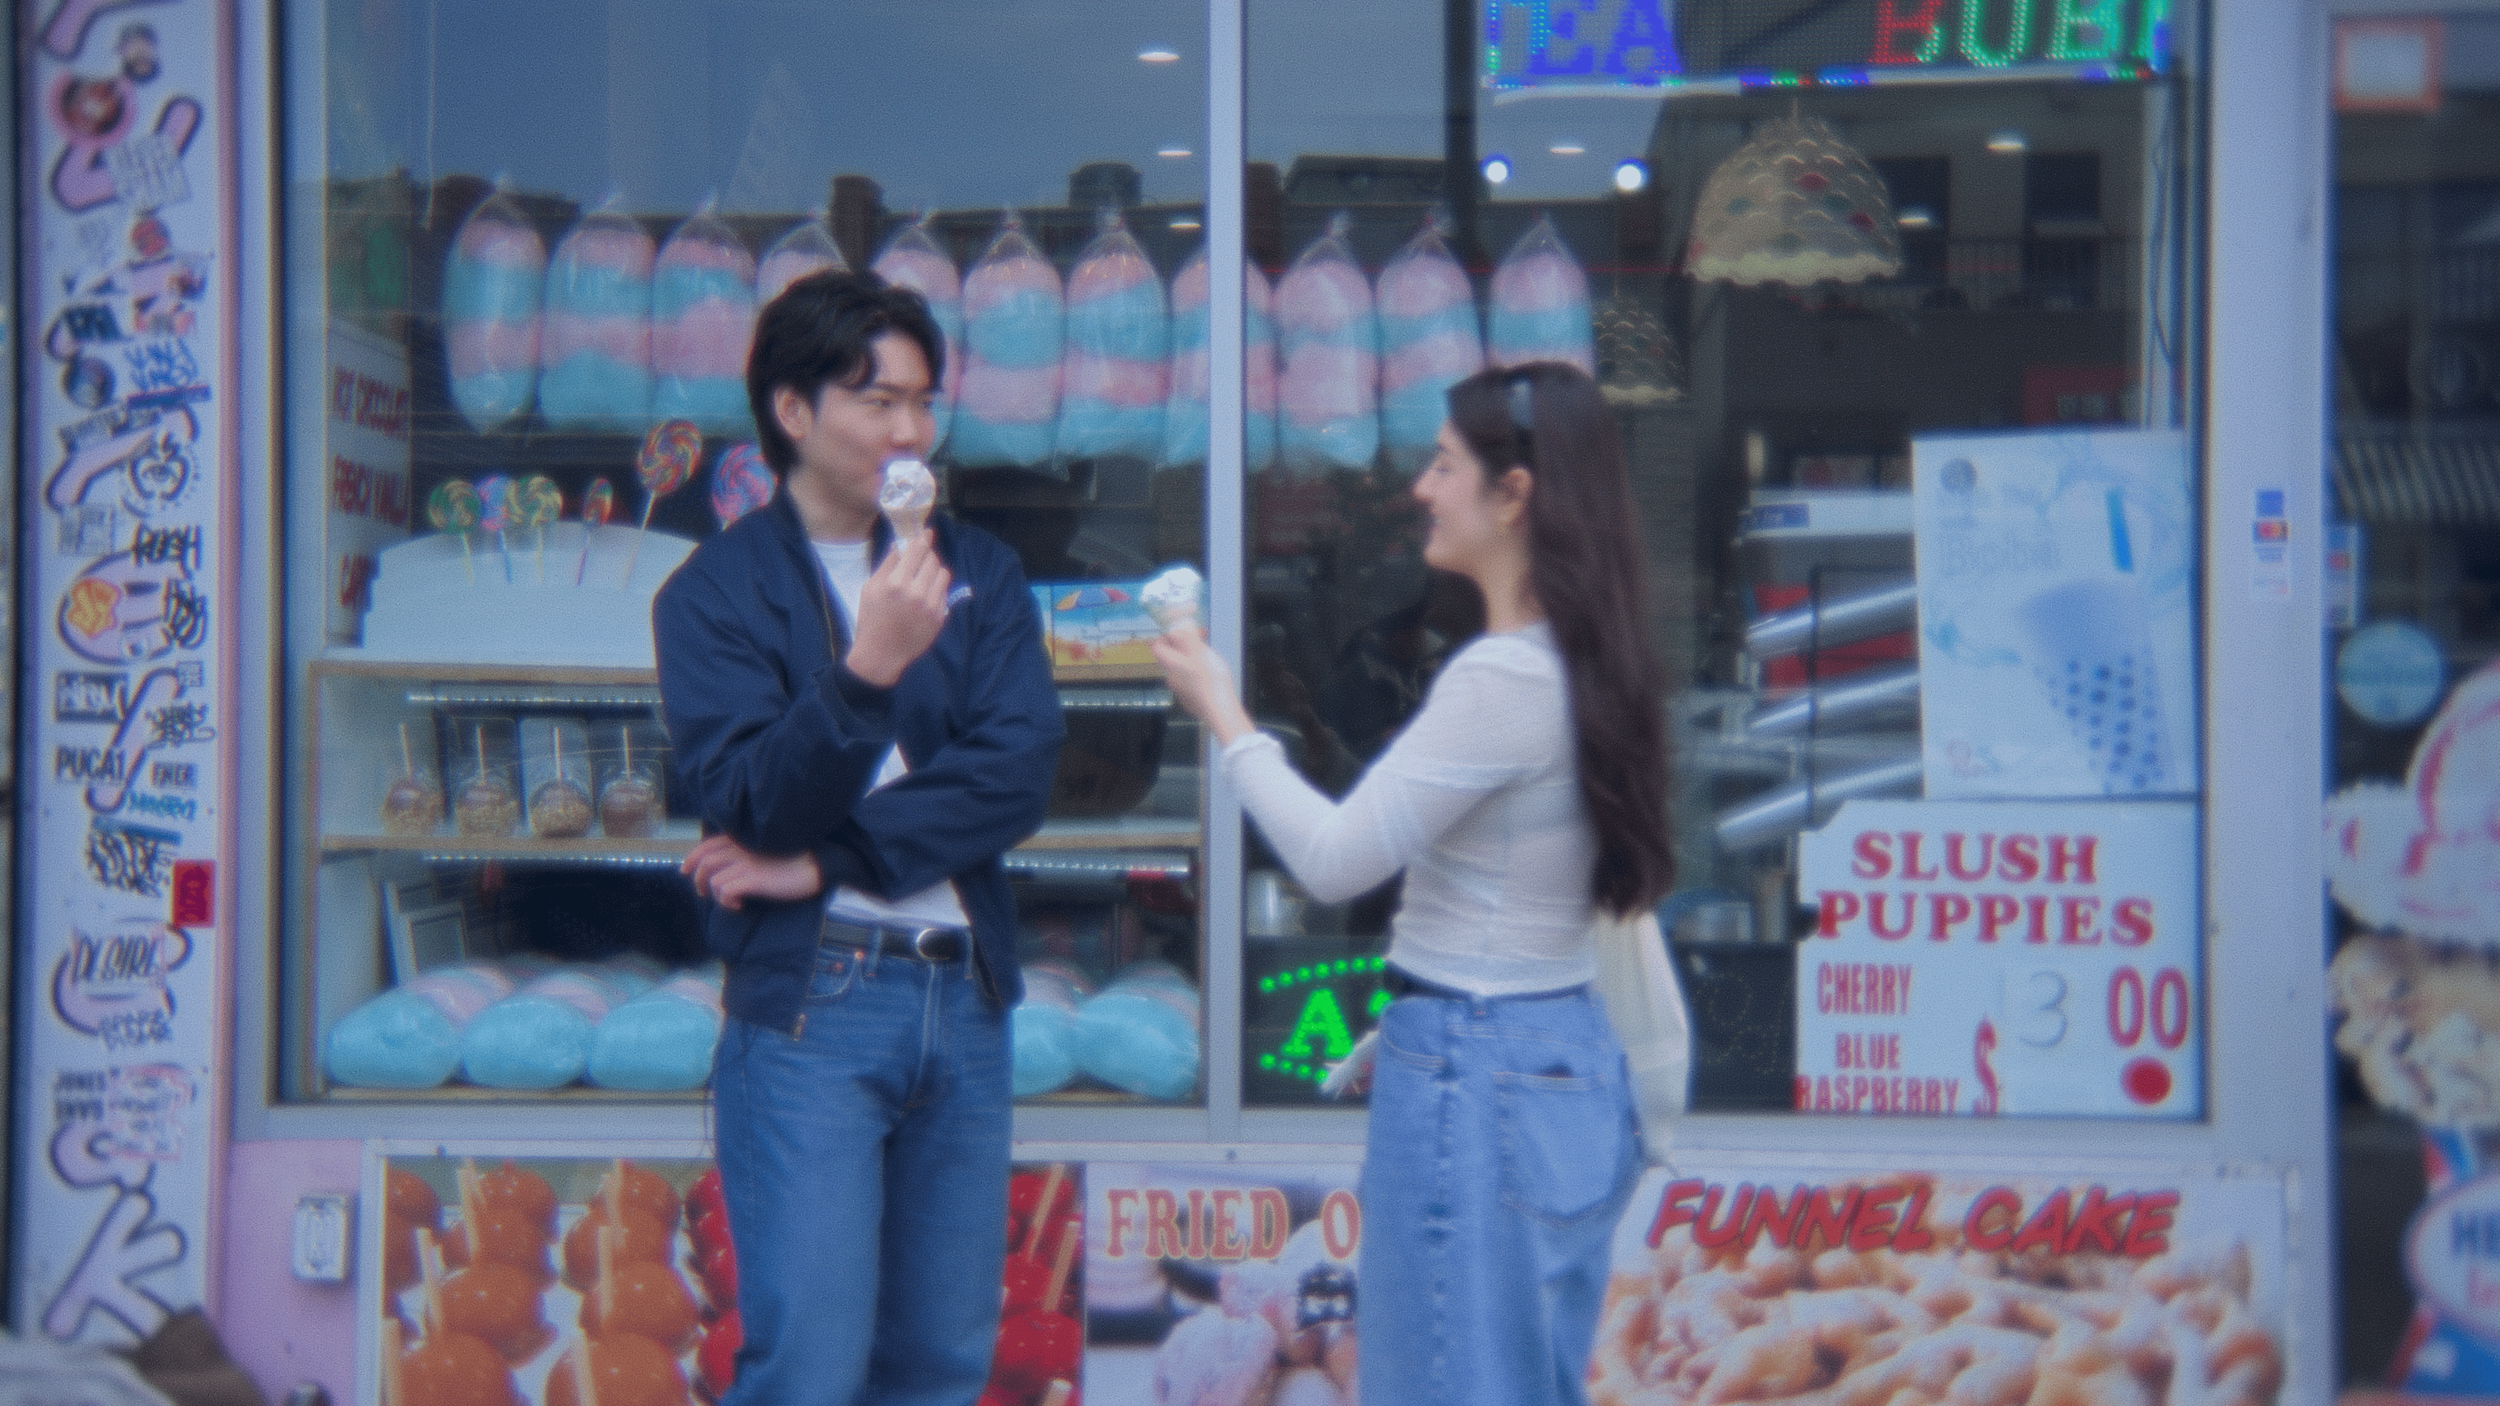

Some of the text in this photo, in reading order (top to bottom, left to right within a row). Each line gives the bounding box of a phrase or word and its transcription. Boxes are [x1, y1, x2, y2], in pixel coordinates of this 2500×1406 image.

[1849, 829, 2100, 885] SLUSH
[1816, 889, 2155, 947] PUPPIES
[1816, 960, 1913, 1016] CHERRY
[2105, 963, 2190, 1051] 00
[1835, 1032, 1902, 1070] BLUE
[1796, 1073, 1960, 1113] RASPBERRY
[1105, 1187, 1290, 1261] FRIED
[1645, 1175, 2182, 1257] FUNNEL CAKE
